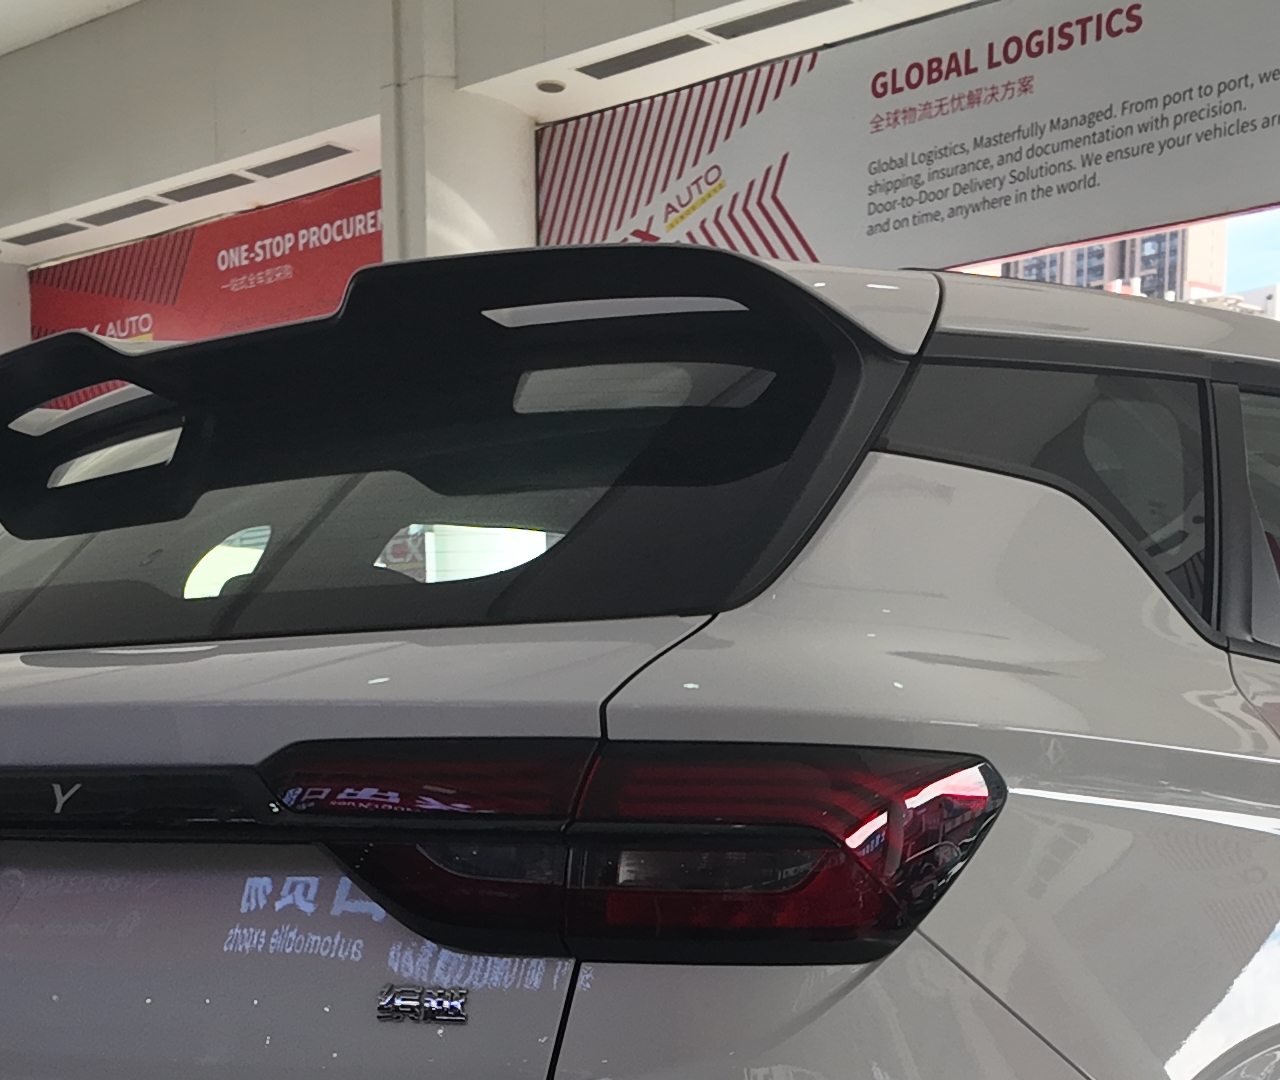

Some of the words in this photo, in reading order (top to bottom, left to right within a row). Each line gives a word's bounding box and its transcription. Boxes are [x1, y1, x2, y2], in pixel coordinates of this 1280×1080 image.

[871, 48, 978, 98] GLOBAL
[987, 3, 1143, 70] LOGISTICS
[868, 153, 908, 175] Global
[911, 142, 969, 166] Logistics,
[973, 122, 1046, 151] Masterfully
[1049, 104, 1117, 133] Managed.
[1121, 97, 1158, 116] From
[1162, 88, 1194, 109] port
[1198, 85, 1213, 99] to
[1217, 74, 1255, 97] port,
[1258, 68, 1280, 84] we
[870, 75, 1035, 134] 全球物流无忧解决方案
[867, 173, 926, 196] shipping,
[928, 157, 994, 182] insurance,
[997, 146, 1023, 166] and
[1026, 124, 1133, 160] documentation
[1137, 114, 1169, 134] with
[1173, 99, 1247, 130] precision.
[867, 187, 949, 216] Door-to-Door
[952, 174, 1006, 197] Delivery
[1008, 157, 1076, 185] Solutions.
[1080, 153, 1102, 169] We
[1105, 141, 1155, 163] ensure
[1157, 132, 1192, 155] your
[1195, 118, 1257, 144] vehicles
[663, 164, 722, 223] AUTO
[866, 219, 890, 236] and
[892, 217, 909, 231] on
[912, 208, 945, 226] time,
[947, 192, 1011, 220] anywhere
[1014, 187, 1027, 203] in
[1030, 183, 1053, 201] the
[1056, 172, 1100, 195] world.
[217, 233, 295, 271] ONE-STOP
[105, 313, 153, 339] AUTO
